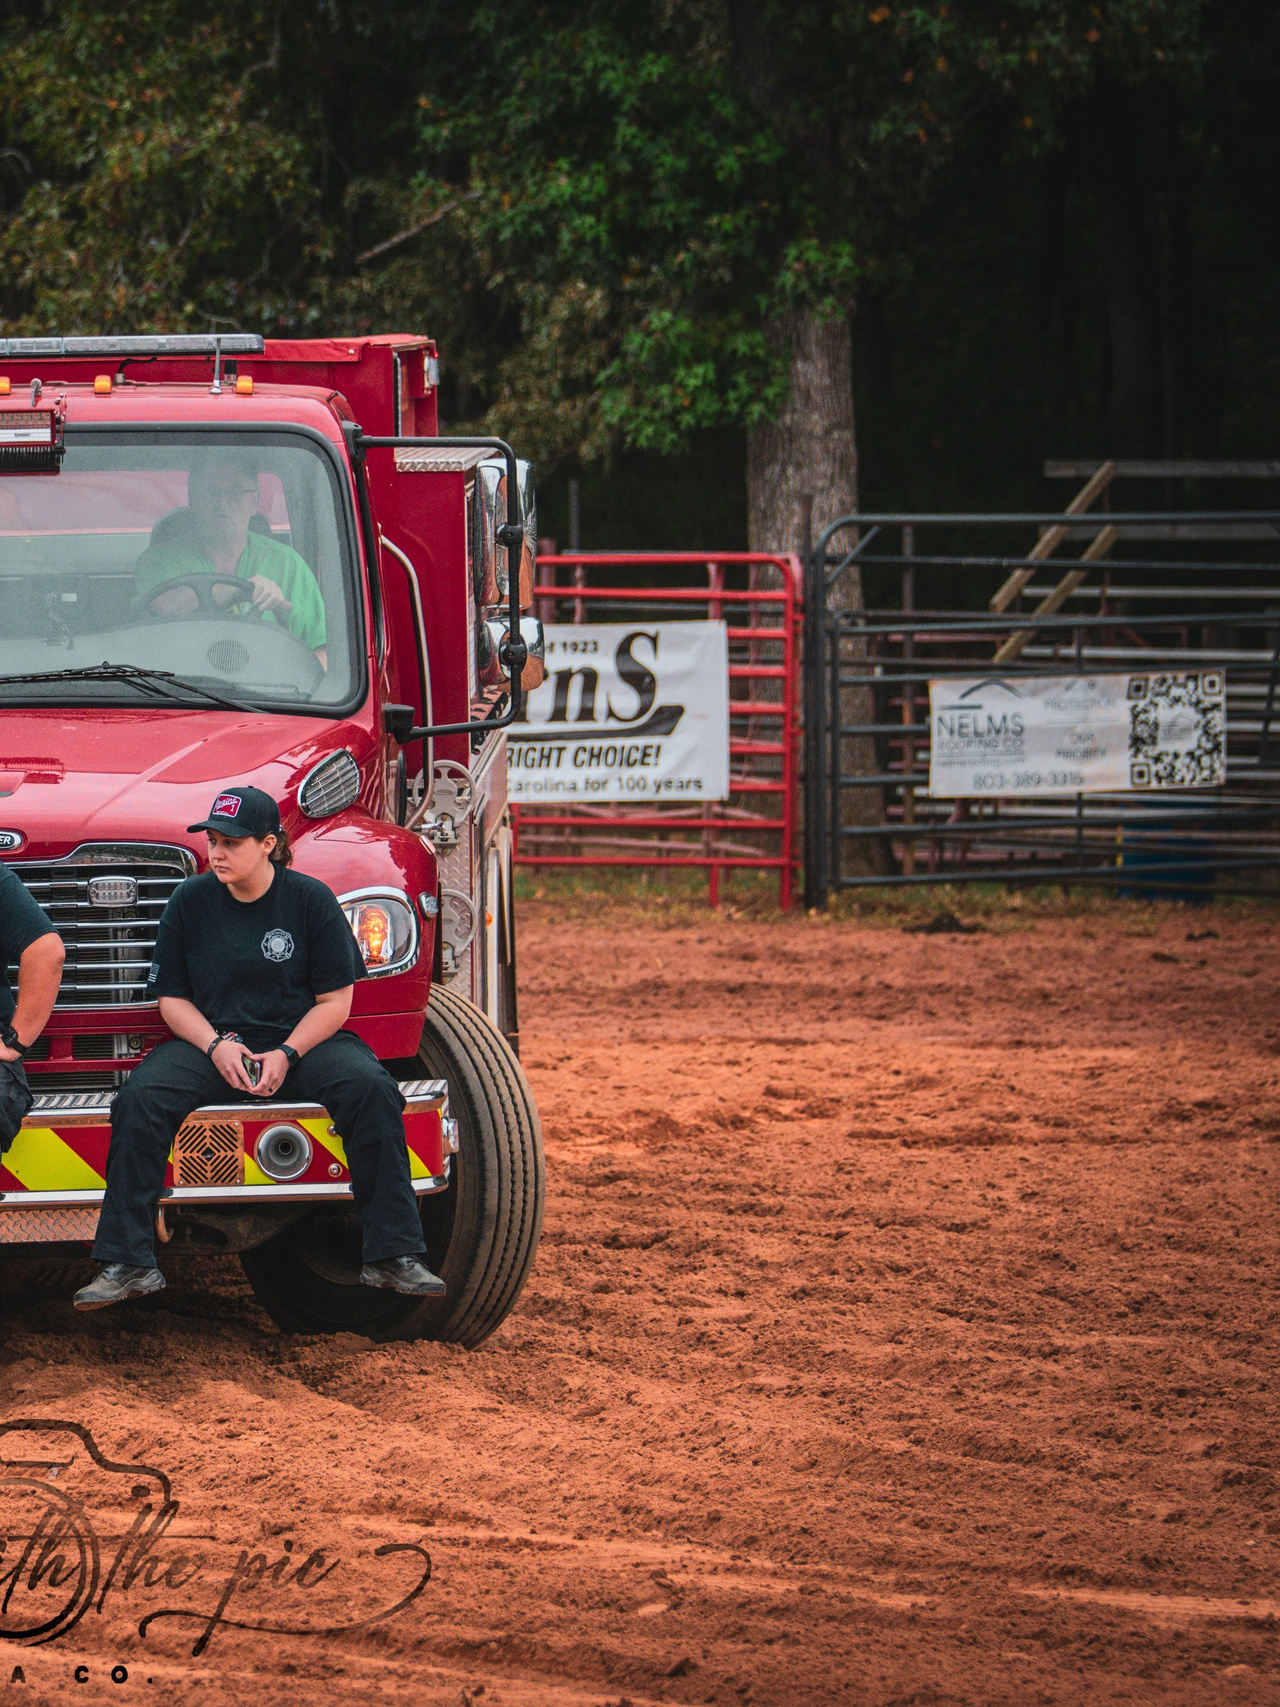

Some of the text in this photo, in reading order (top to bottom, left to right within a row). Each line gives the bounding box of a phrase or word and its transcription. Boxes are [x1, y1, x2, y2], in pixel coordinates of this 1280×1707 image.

[562, 641, 599, 654] 1923
[1043, 694, 1117, 711] PROTECTION
[936, 711, 1026, 738] NELMS
[937, 738, 999, 752] ROOFING
[1055, 746, 1107, 761] PRIORITY
[573, 744, 662, 768] CHOICE!
[585, 777, 609, 792] for
[620, 776, 648, 791] 100
[654, 777, 703, 795] years
